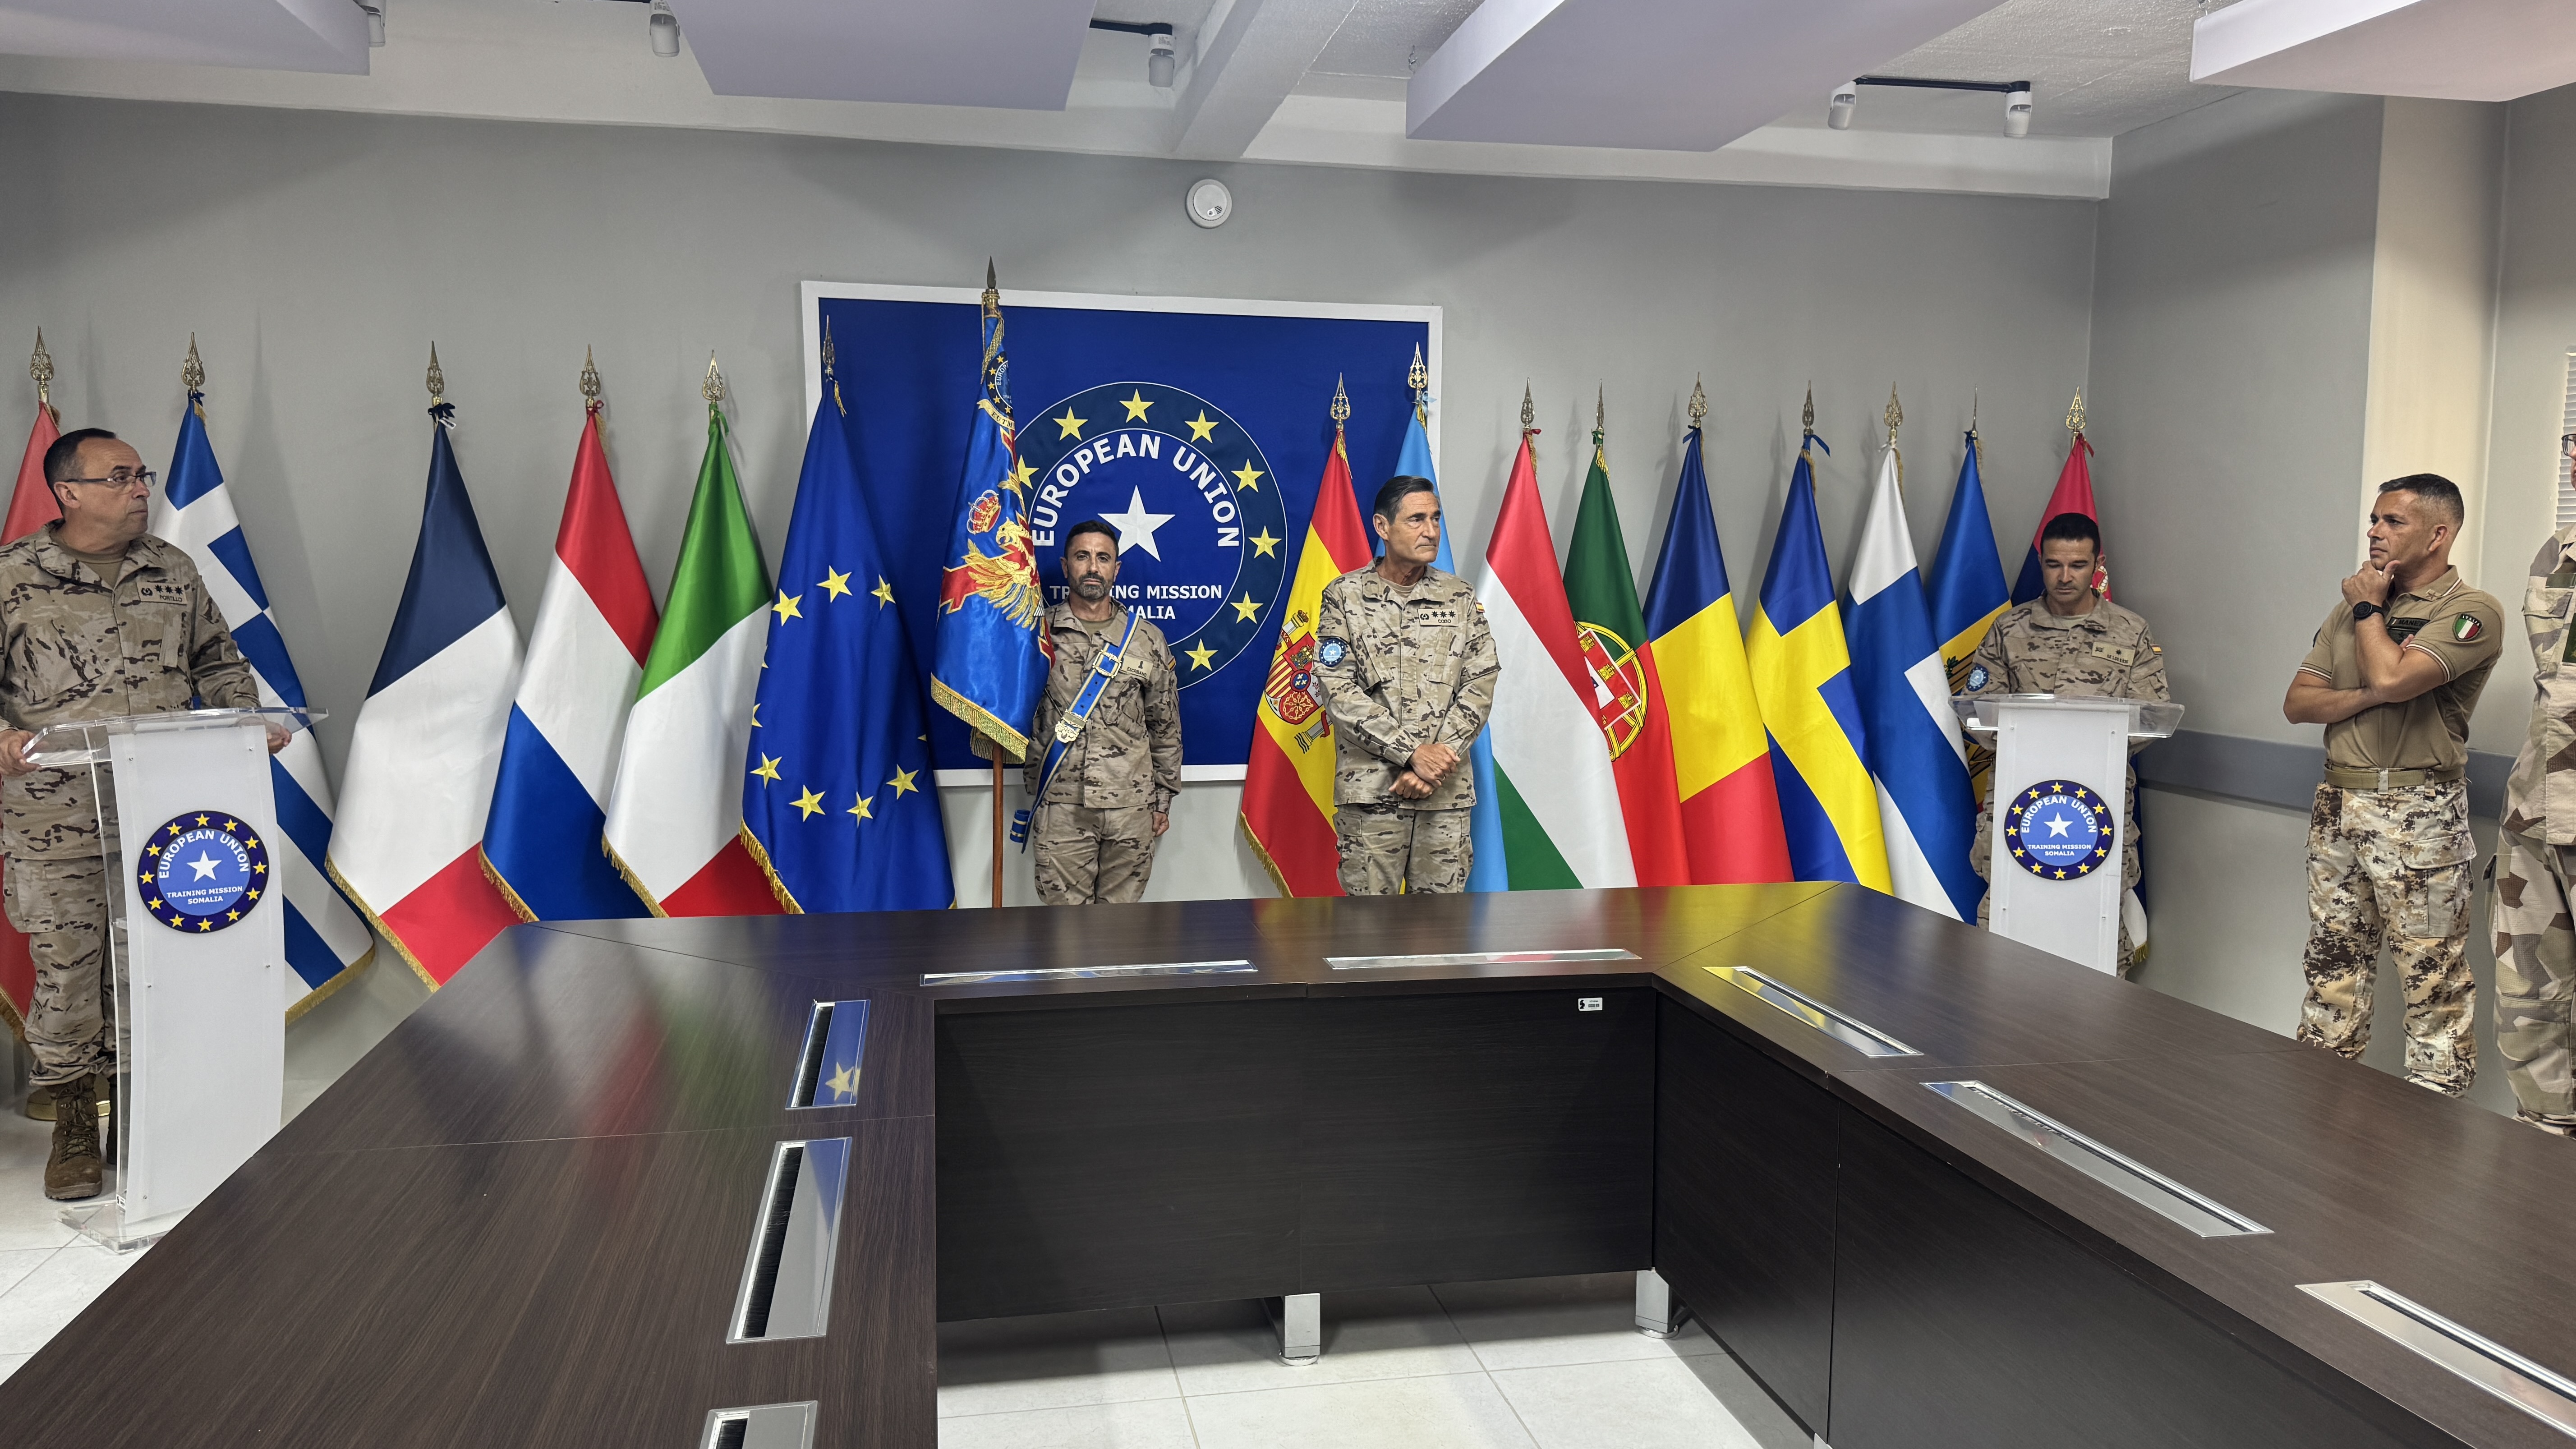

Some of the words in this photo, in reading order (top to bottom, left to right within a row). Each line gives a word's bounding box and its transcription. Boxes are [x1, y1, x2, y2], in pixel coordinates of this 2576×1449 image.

[1031, 433, 1160, 547] EUROPEAN
[1173, 445, 1239, 547] UNION
[1147, 584, 1222, 599] MISSION
[2462, 615, 2480, 626] ITALIA
[2021, 795, 2067, 833] EUROPEAN
[2071, 799, 2097, 833] UNION
[159, 830, 215, 879] EUROPEAN
[220, 833, 249, 872] UNION
[166, 889, 207, 898] TRAINING
[208, 886, 243, 895] MISSION
[188, 896, 223, 905] SOMALIA
